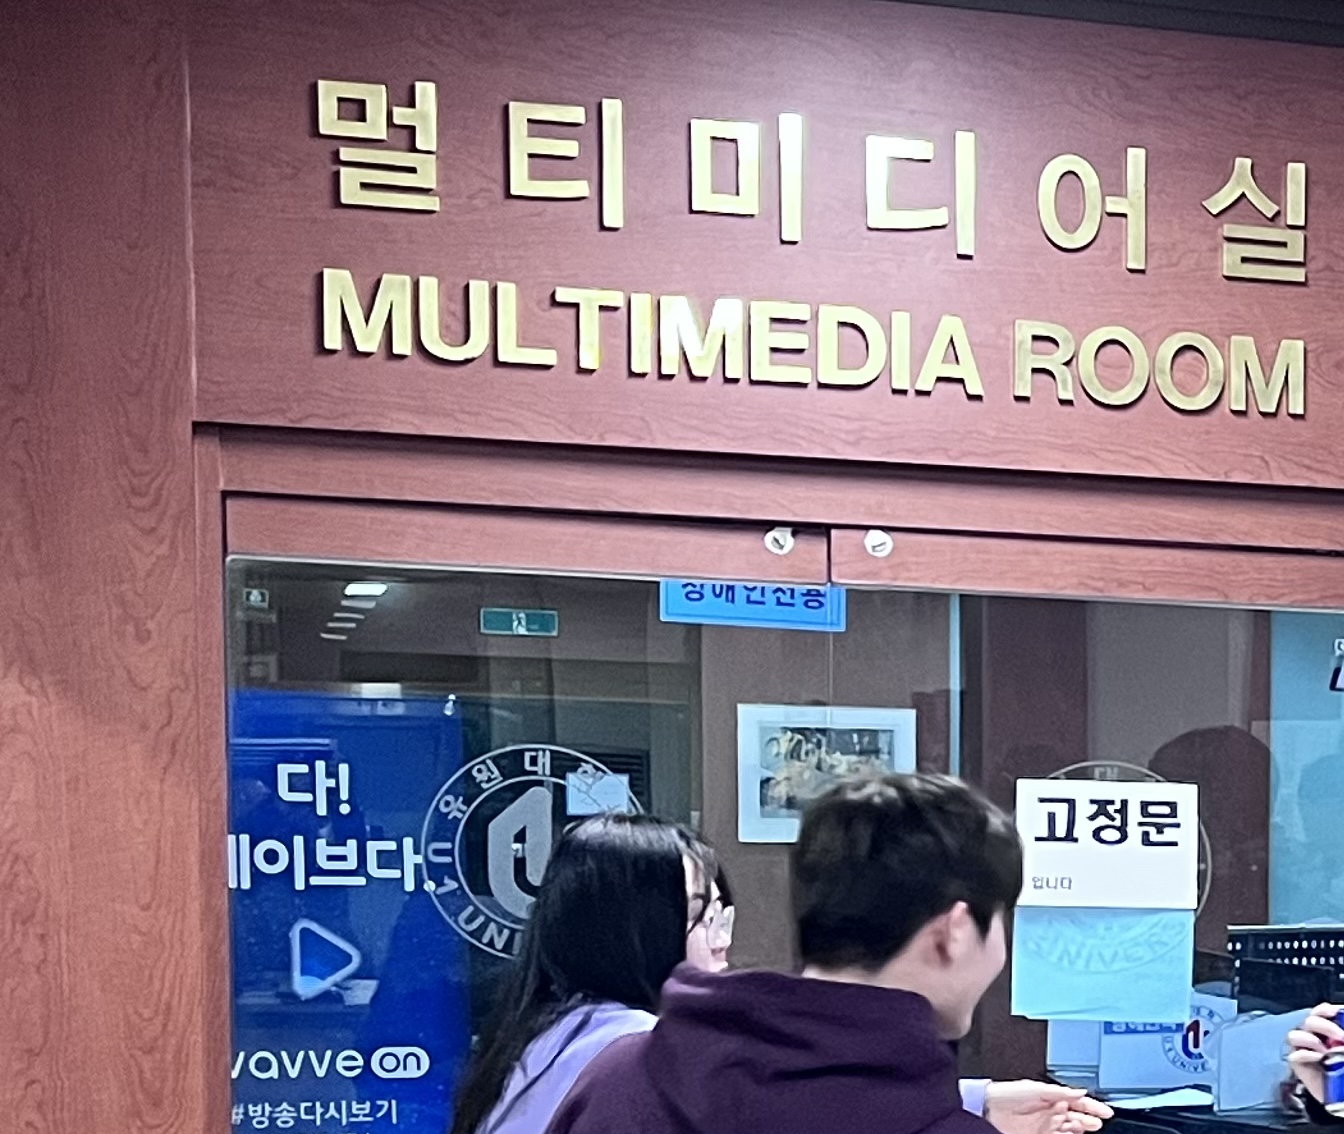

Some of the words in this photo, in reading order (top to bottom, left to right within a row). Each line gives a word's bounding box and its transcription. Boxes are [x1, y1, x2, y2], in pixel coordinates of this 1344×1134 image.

[317, 78, 1307, 282] 멀티미디어실
[322, 267, 983, 399] MULTIMEDIA
[1013, 319, 1306, 416] ROOM
[277, 760, 351, 816] 다!
[1034, 797, 1181, 847] 고정문
[379, 1051, 421, 1074] on
[231, 1099, 398, 1129] #방송다시보기
